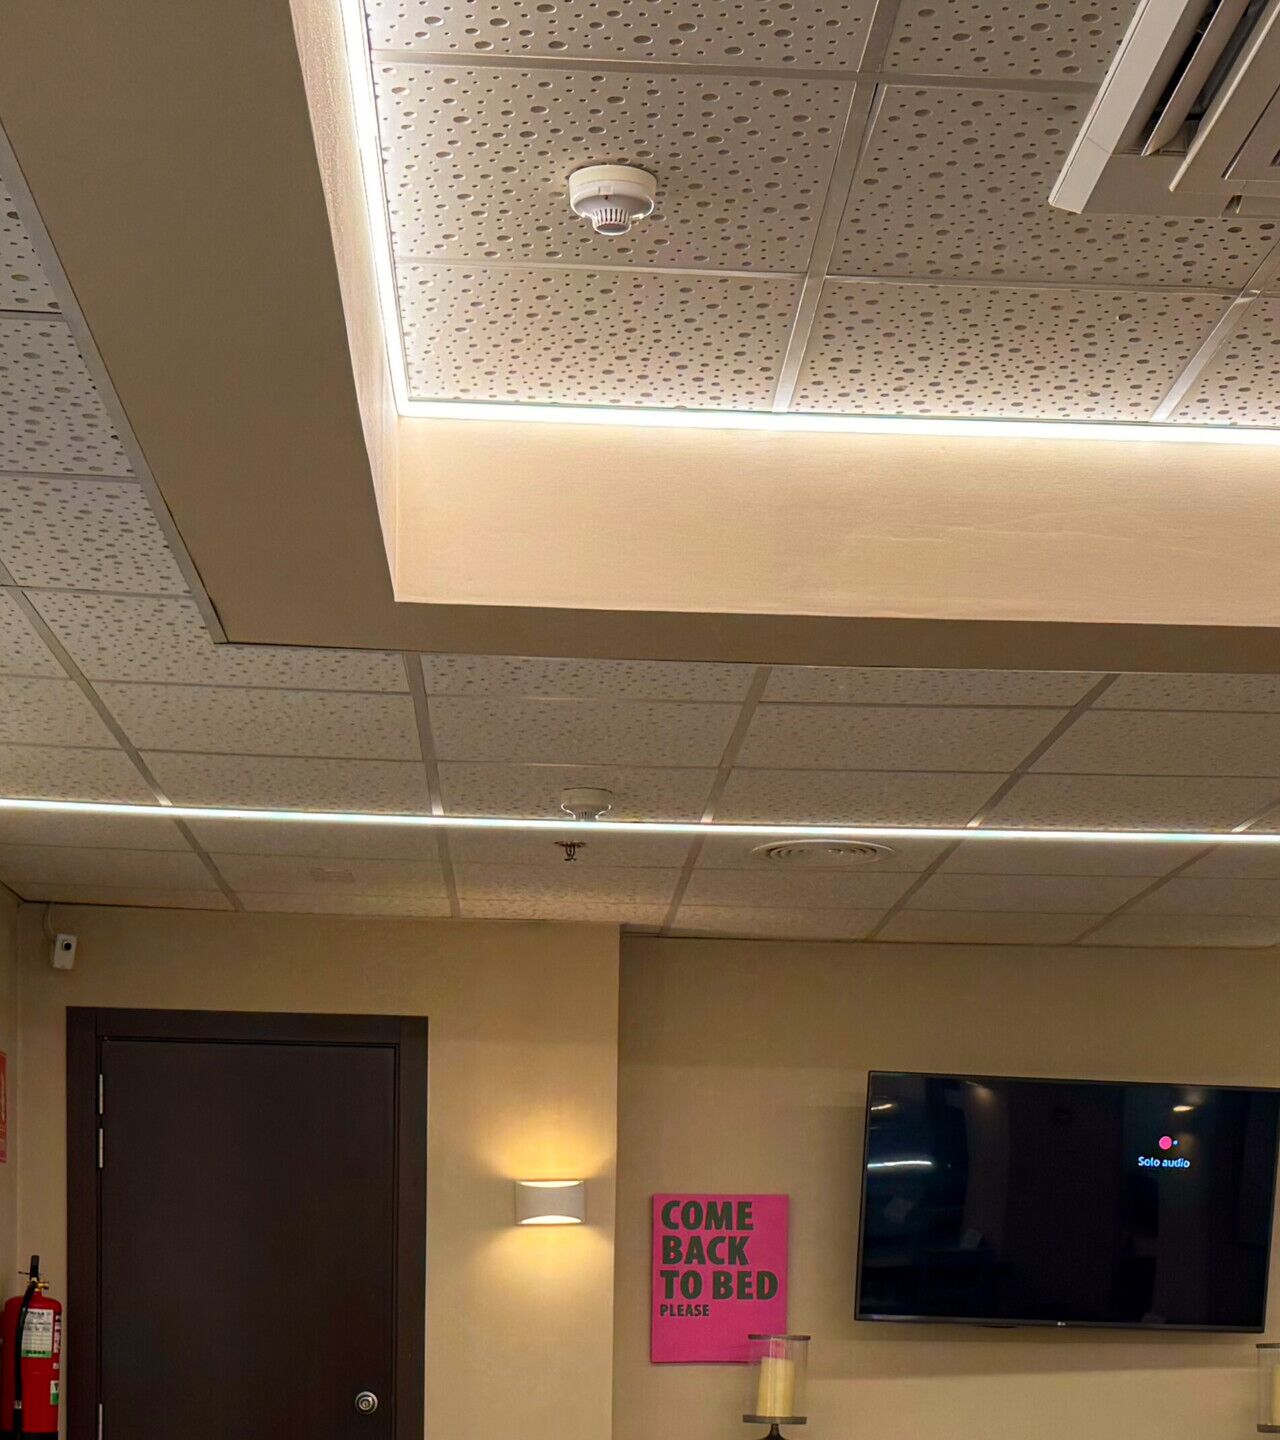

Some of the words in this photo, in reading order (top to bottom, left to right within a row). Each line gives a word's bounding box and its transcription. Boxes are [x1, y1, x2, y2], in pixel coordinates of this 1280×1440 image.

[1138, 1156, 1160, 1168] Solo
[1162, 1158, 1190, 1168] audio
[661, 1200, 754, 1231] COME
[662, 1235, 750, 1266] BACK
[660, 1270, 702, 1300] TO
[712, 1271, 778, 1300] BED
[660, 1304, 710, 1317] PLEASE
